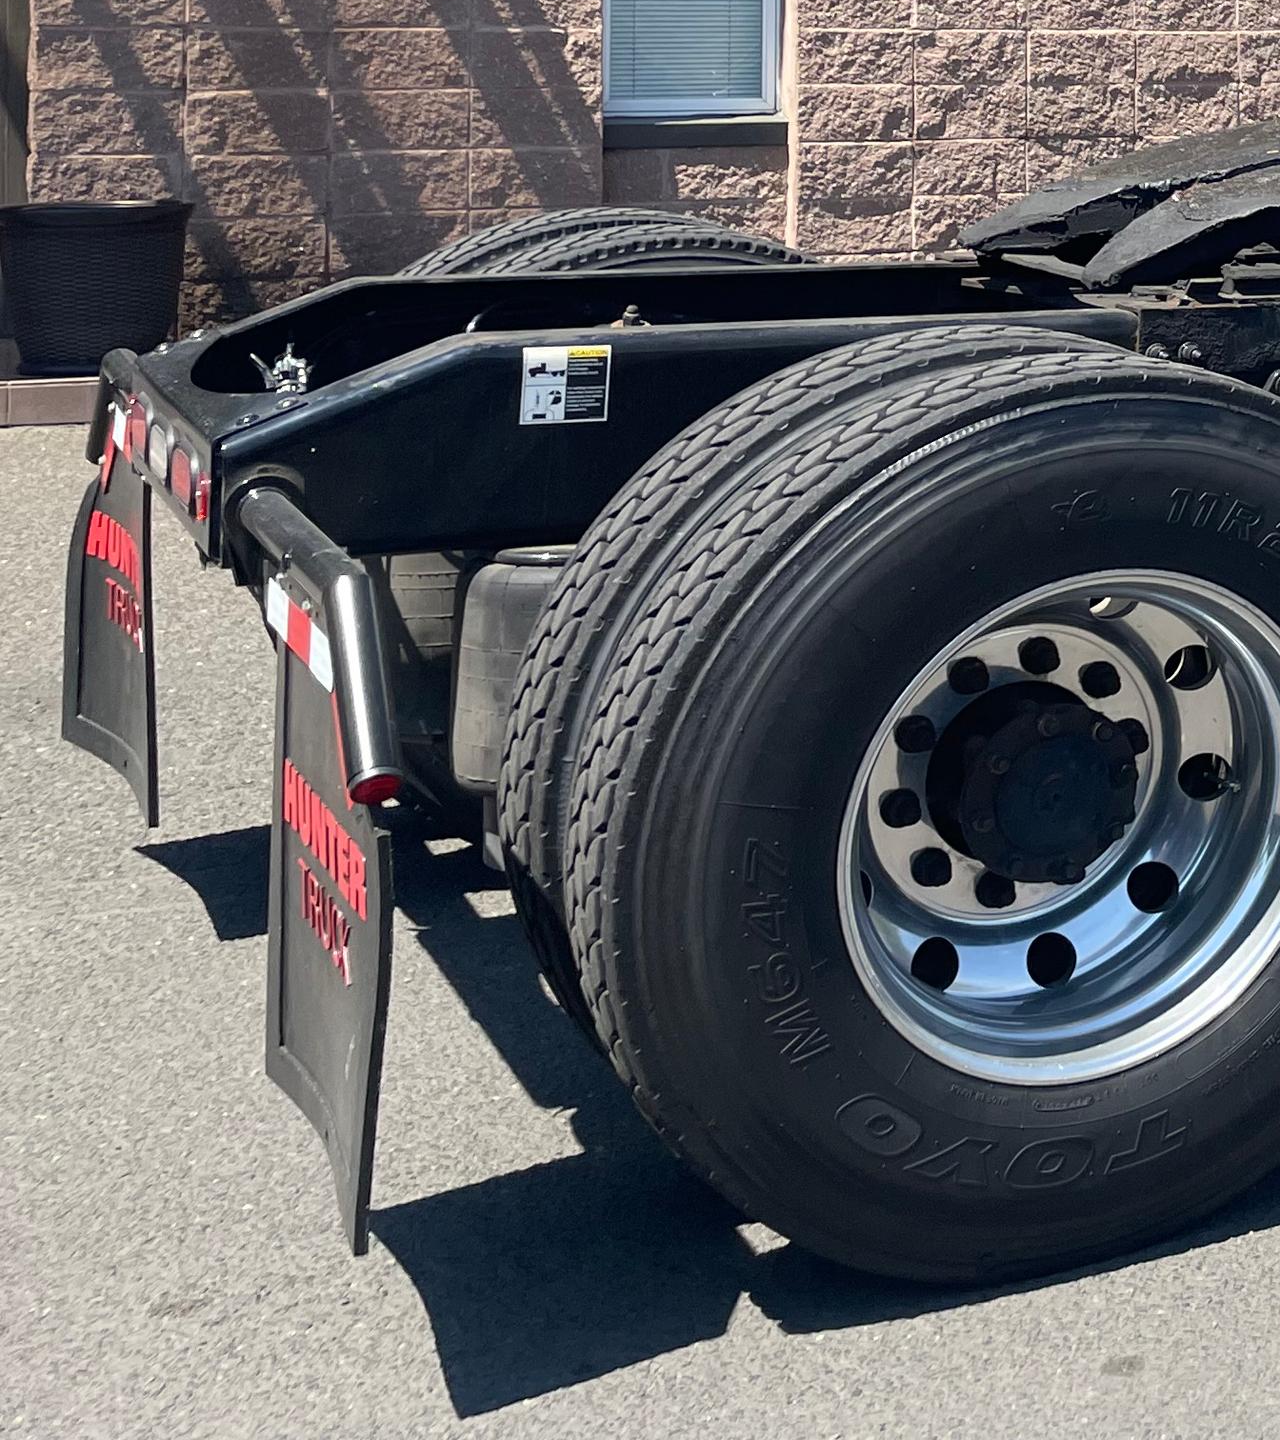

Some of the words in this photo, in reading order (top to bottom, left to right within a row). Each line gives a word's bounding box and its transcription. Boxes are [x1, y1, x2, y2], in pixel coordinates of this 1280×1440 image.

[283, 758, 368, 922] HUNTER
[298, 857, 352, 987] TRUCK
[739, 836, 833, 1071] M647
[834, 1090, 1194, 1190] TOYO
